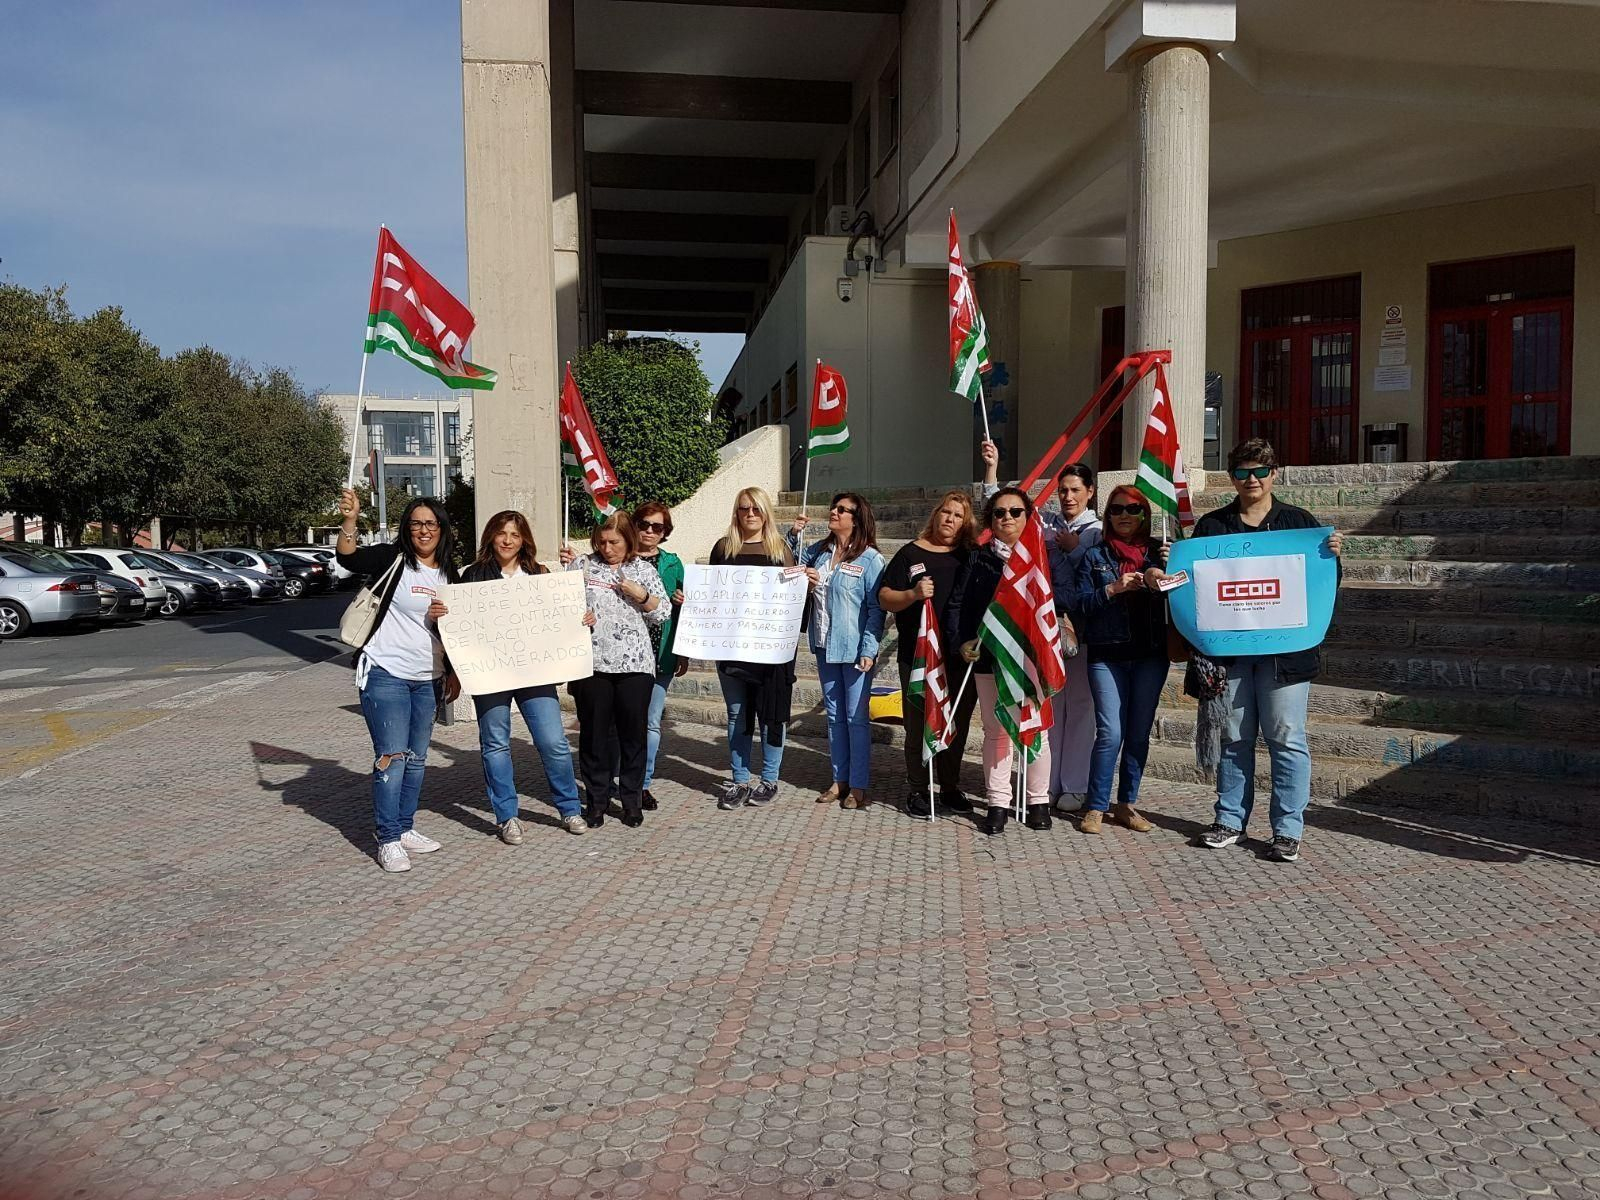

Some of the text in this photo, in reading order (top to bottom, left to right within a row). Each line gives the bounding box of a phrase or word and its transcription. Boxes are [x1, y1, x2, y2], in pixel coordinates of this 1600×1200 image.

[1204, 541, 1254, 559] UGR
[685, 590, 708, 601] NOS
[711, 590, 749, 600] APLICA
[1222, 582, 1277, 599] CCOO
[451, 599, 511, 616] CUBRE
[519, 594, 544, 606] LAS
[724, 607, 738, 616] UN
[743, 607, 790, 617] ACUERDO
[445, 618, 485, 634] CON
[447, 637, 470, 650] DE
[493, 640, 526, 658] NO
[702, 640, 715, 648] EL
